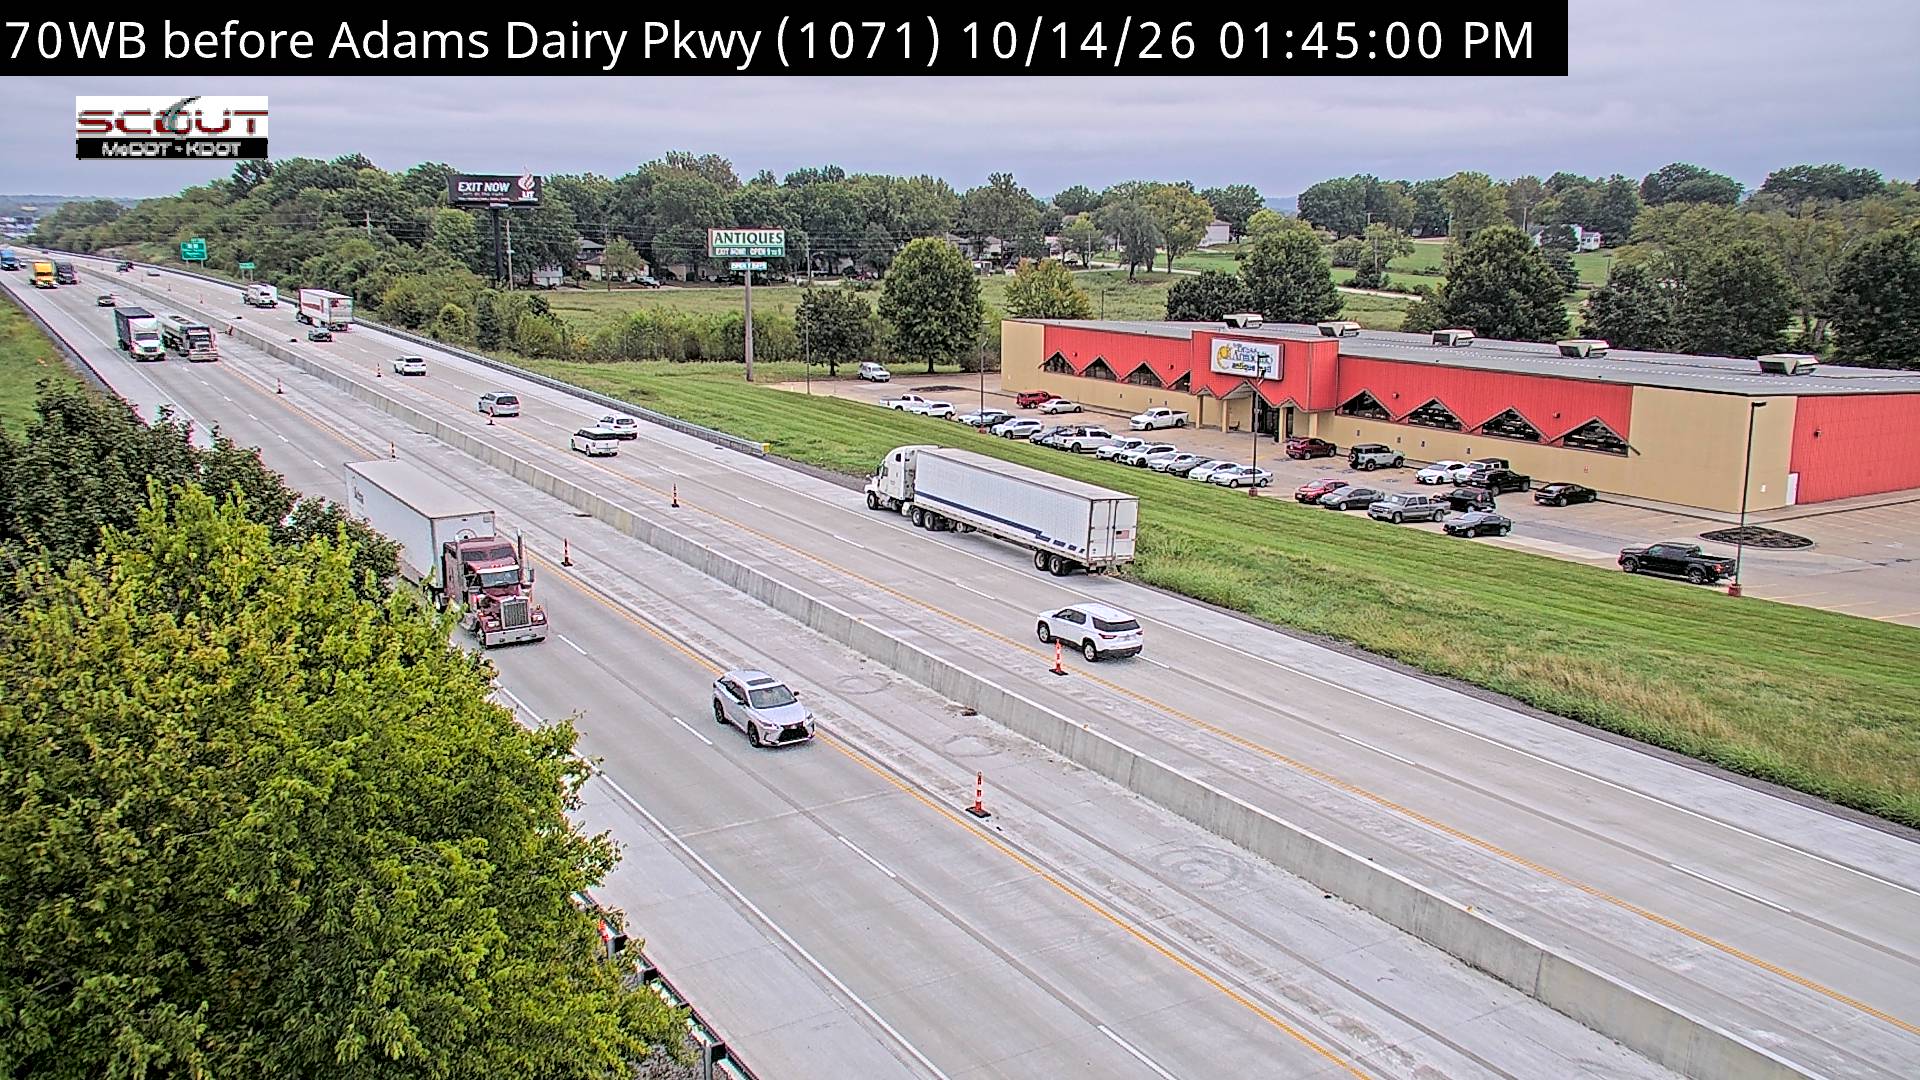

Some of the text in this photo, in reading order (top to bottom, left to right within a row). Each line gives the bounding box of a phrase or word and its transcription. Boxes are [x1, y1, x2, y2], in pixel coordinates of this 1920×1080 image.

[458, 182, 510, 192] EXIT NOW
[715, 232, 783, 245] ANTIQUES
[749, 247, 766, 256] OPEN
